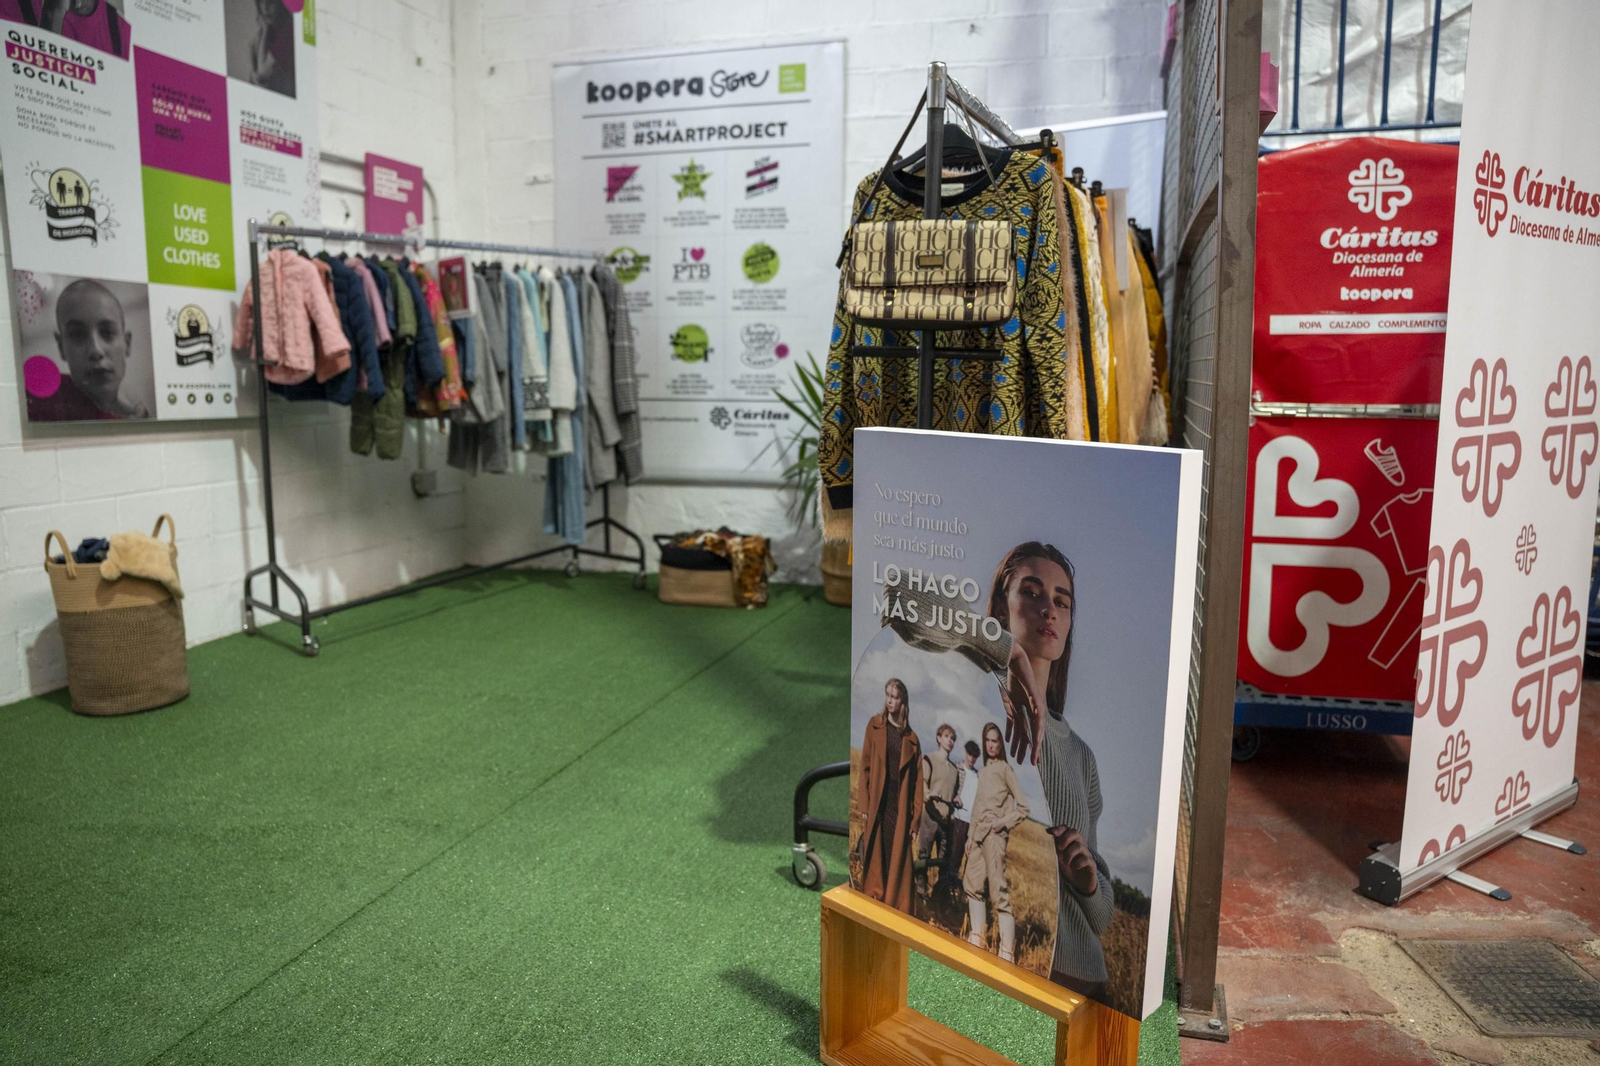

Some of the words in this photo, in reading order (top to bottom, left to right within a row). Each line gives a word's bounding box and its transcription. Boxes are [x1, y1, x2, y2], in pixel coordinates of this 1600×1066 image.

[8, 30, 104, 71] QUEREMOS
[11, 47, 92, 82] JUSTICIA
[12, 62, 84, 95] SOCIAL.
[587, 77, 704, 103] koopera
[710, 70, 769, 98] Store
[634, 122, 788, 147] #SMARTPROJECT
[665, 119, 677, 128] AL
[1513, 166, 1600, 218] Cáritas
[174, 203, 207, 224] LOVE
[174, 225, 209, 246] USED
[1320, 226, 1438, 249] Cáritas
[1510, 214, 1561, 241] Diocesana
[1562, 224, 1574, 243] de
[163, 246, 221, 269] CLOTHES
[1332, 251, 1404, 264] Diocesana
[1406, 249, 1423, 262] de
[673, 264, 710, 280] PTB
[1350, 264, 1404, 278] Almería
[1340, 286, 1413, 302] koopera
[1299, 321, 1322, 329] ROPA
[1329, 321, 1370, 329] CALZADO
[875, 482, 893, 500] No
[896, 489, 942, 508] espero
[873, 510, 898, 527] que
[901, 511, 913, 527] el
[916, 517, 968, 535] mundo
[873, 533, 895, 548] sea
[899, 537, 927, 554] más
[928, 540, 965, 560] justo
[873, 561, 902, 587] LO
[908, 567, 980, 603] HAGO
[872, 592, 919, 624] MÁS
[925, 605, 1002, 642] JUSTO
[1306, 712, 1367, 731] LUSSO
